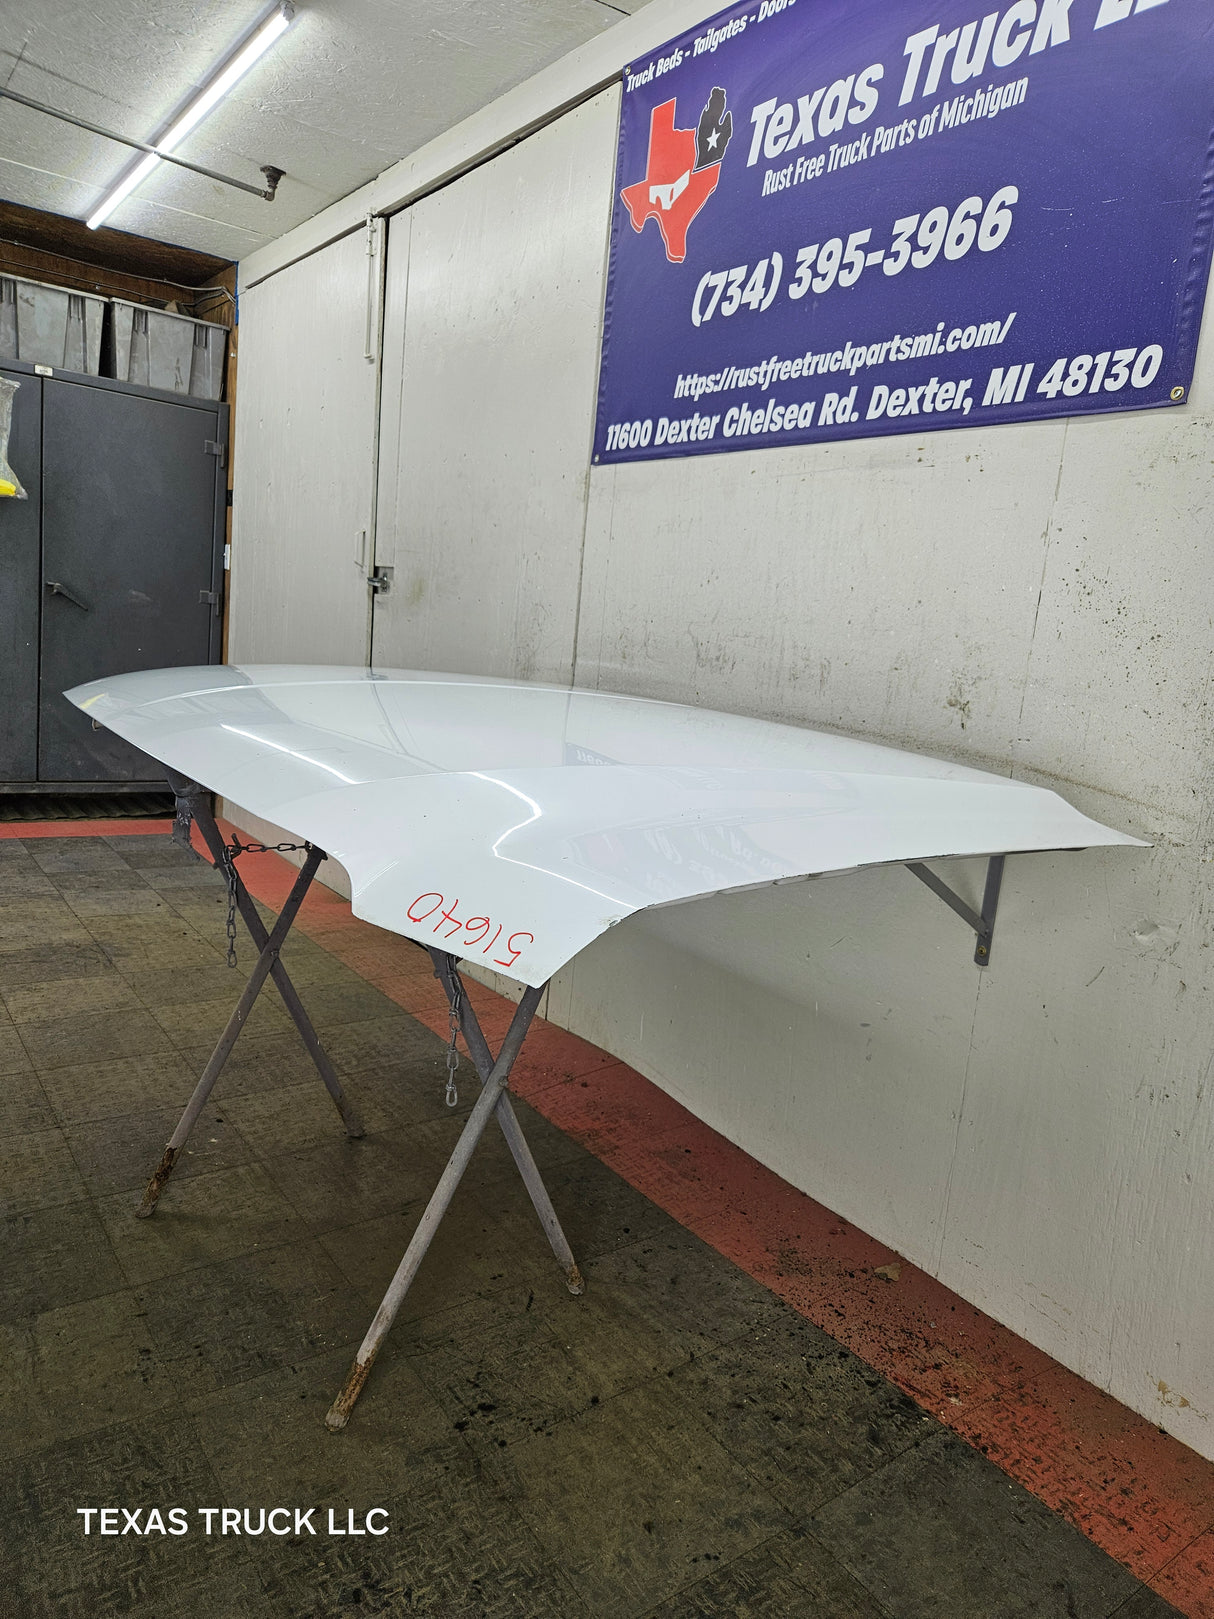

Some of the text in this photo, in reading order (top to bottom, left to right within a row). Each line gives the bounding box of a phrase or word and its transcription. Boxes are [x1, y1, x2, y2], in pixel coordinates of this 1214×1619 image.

[626, 62, 656, 93] Truck
[655, 47, 684, 78] Beds
[693, 14, 748, 58] Tailgates
[746, 0, 1075, 167] Texas Truck
[762, 76, 1029, 197] Rust Free Truck Parts of Michigan
[691, 185, 1019, 327] (734) 395-3966
[605, 344, 1164, 451] 11600 Dexter Chelsea Rd. Dexter, MI 48130
[673, 312, 1017, 401] https://rustfreetruckpartsmi.com/
[406, 892, 534, 967] 51640
